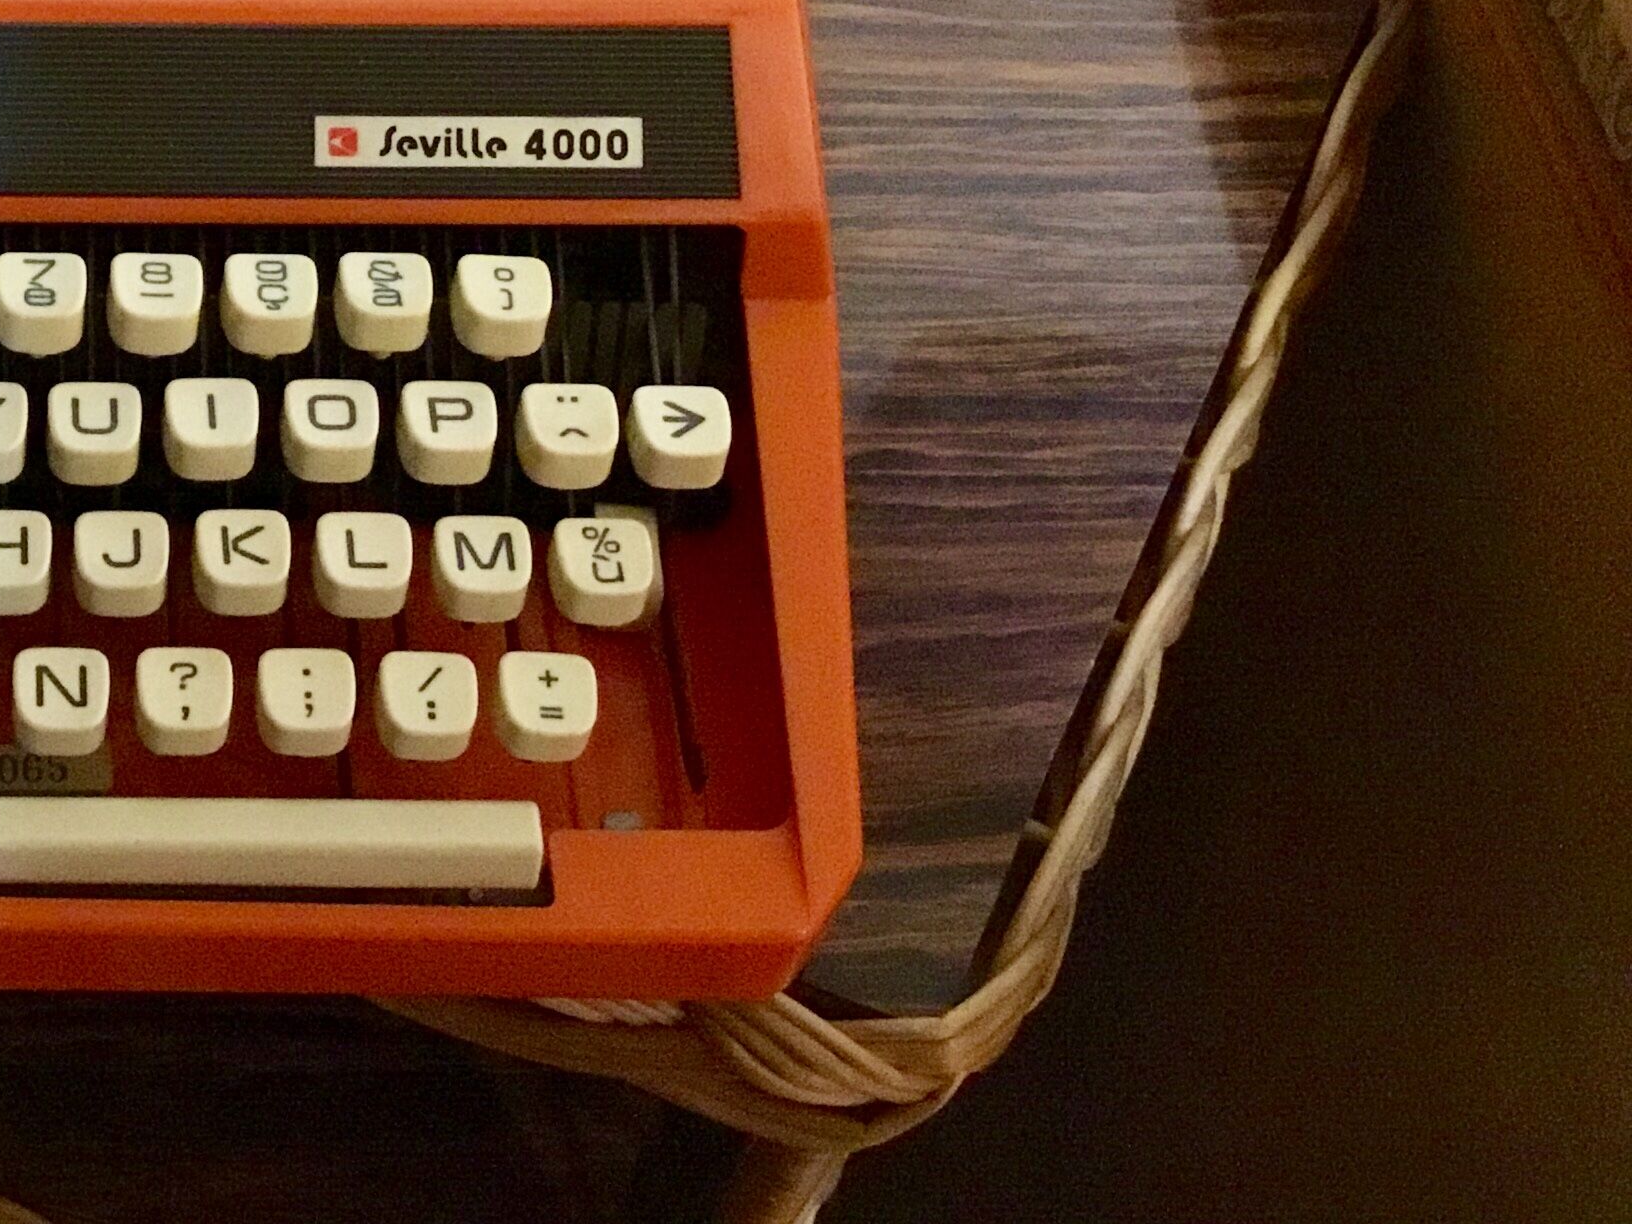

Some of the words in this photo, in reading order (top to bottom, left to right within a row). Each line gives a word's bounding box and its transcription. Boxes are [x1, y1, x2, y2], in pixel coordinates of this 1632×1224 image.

[379, 125, 508, 159] Seville
[524, 128, 629, 161] 4000
[22, 257, 57, 283] 7
[140, 261, 173, 285] 8
[255, 260, 288, 283] 9
[257, 283, 290, 311] ç
[71, 397, 119, 435] U
[206, 393, 217, 430] I
[307, 394, 357, 431] O
[427, 397, 474, 433] P
[102, 528, 142, 569] J
[220, 525, 270, 565] K
[345, 529, 388, 570] L
[453, 531, 516, 572] M
[581, 526, 621, 554] %
[35, 664, 88, 708] N
[169, 662, 198, 690] ?
[418, 666, 443, 692] /
[538, 669, 559, 688] +
[540, 706, 564, 720] =
